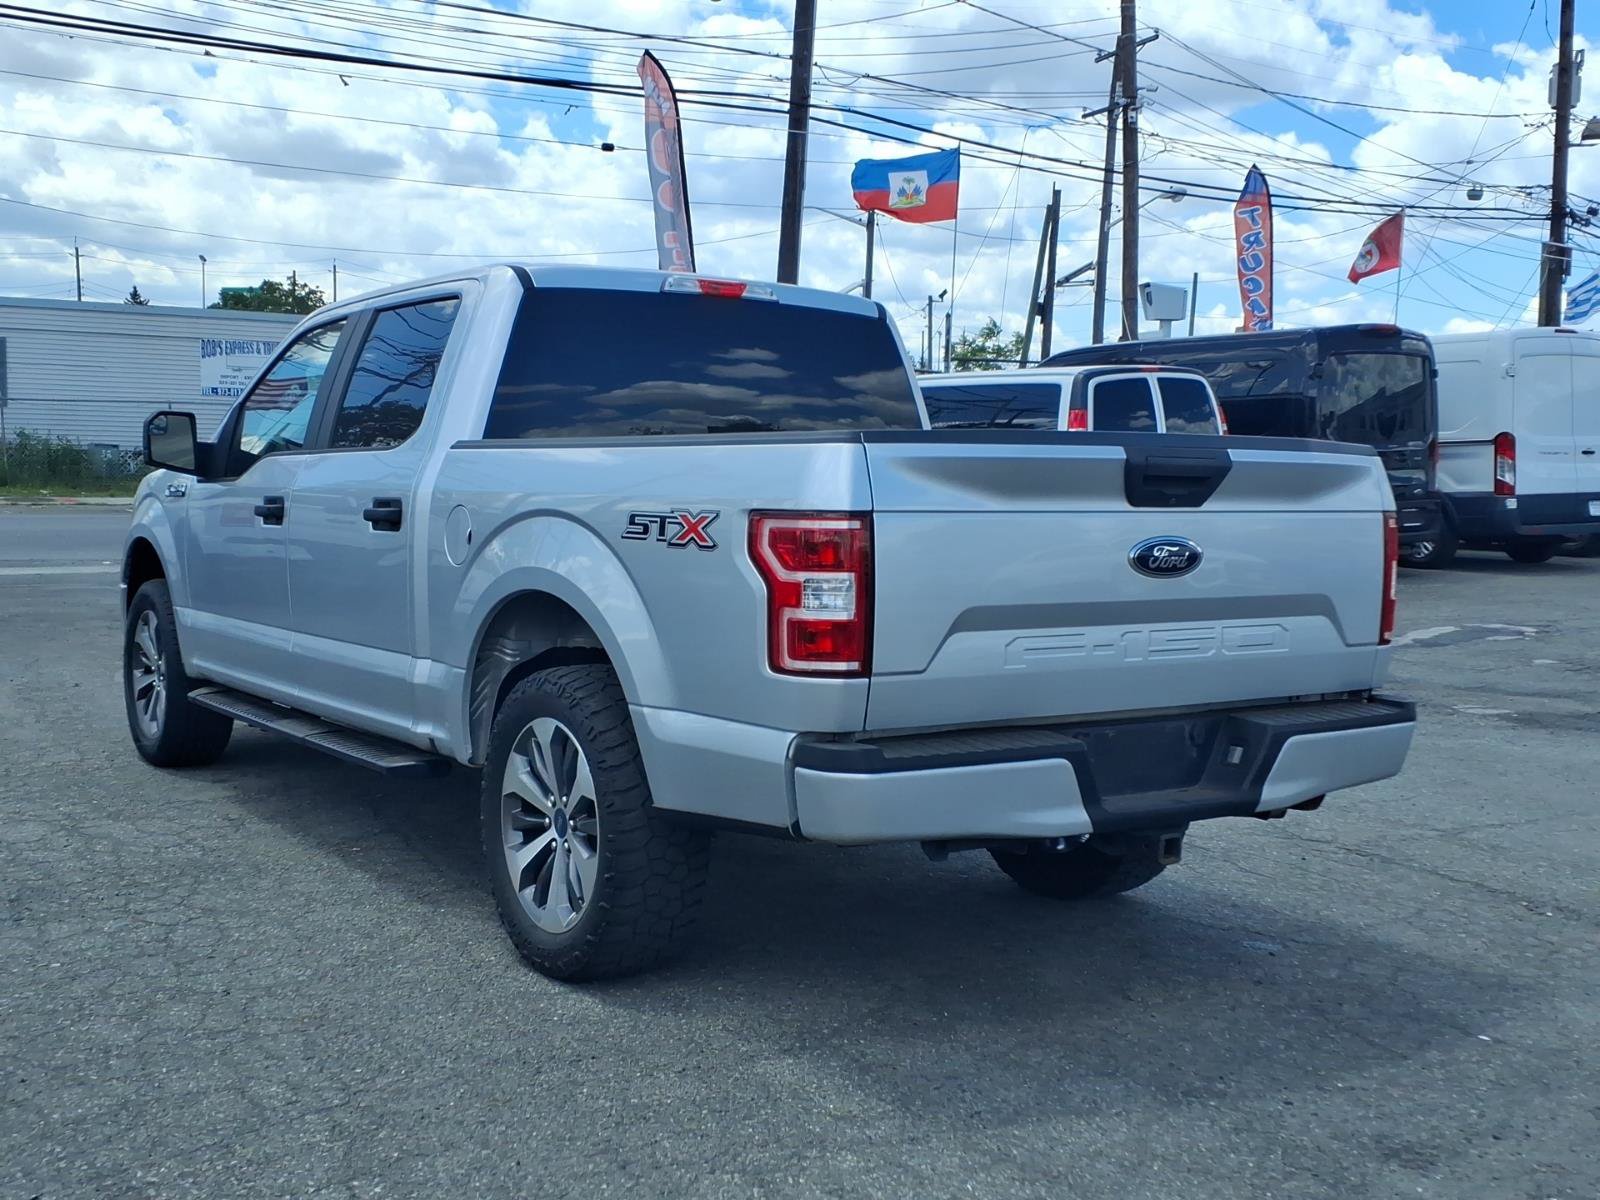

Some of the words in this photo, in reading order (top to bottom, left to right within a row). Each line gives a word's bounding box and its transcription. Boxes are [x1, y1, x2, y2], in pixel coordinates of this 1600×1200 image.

[201, 339, 224, 358] BOB'S
[224, 340, 255, 355] EXPRESS
[255, 341, 262, 354] &
[621, 508, 720, 551] STX
[1148, 545, 1190, 569] Ford
[1003, 623, 1290, 669] F-150
